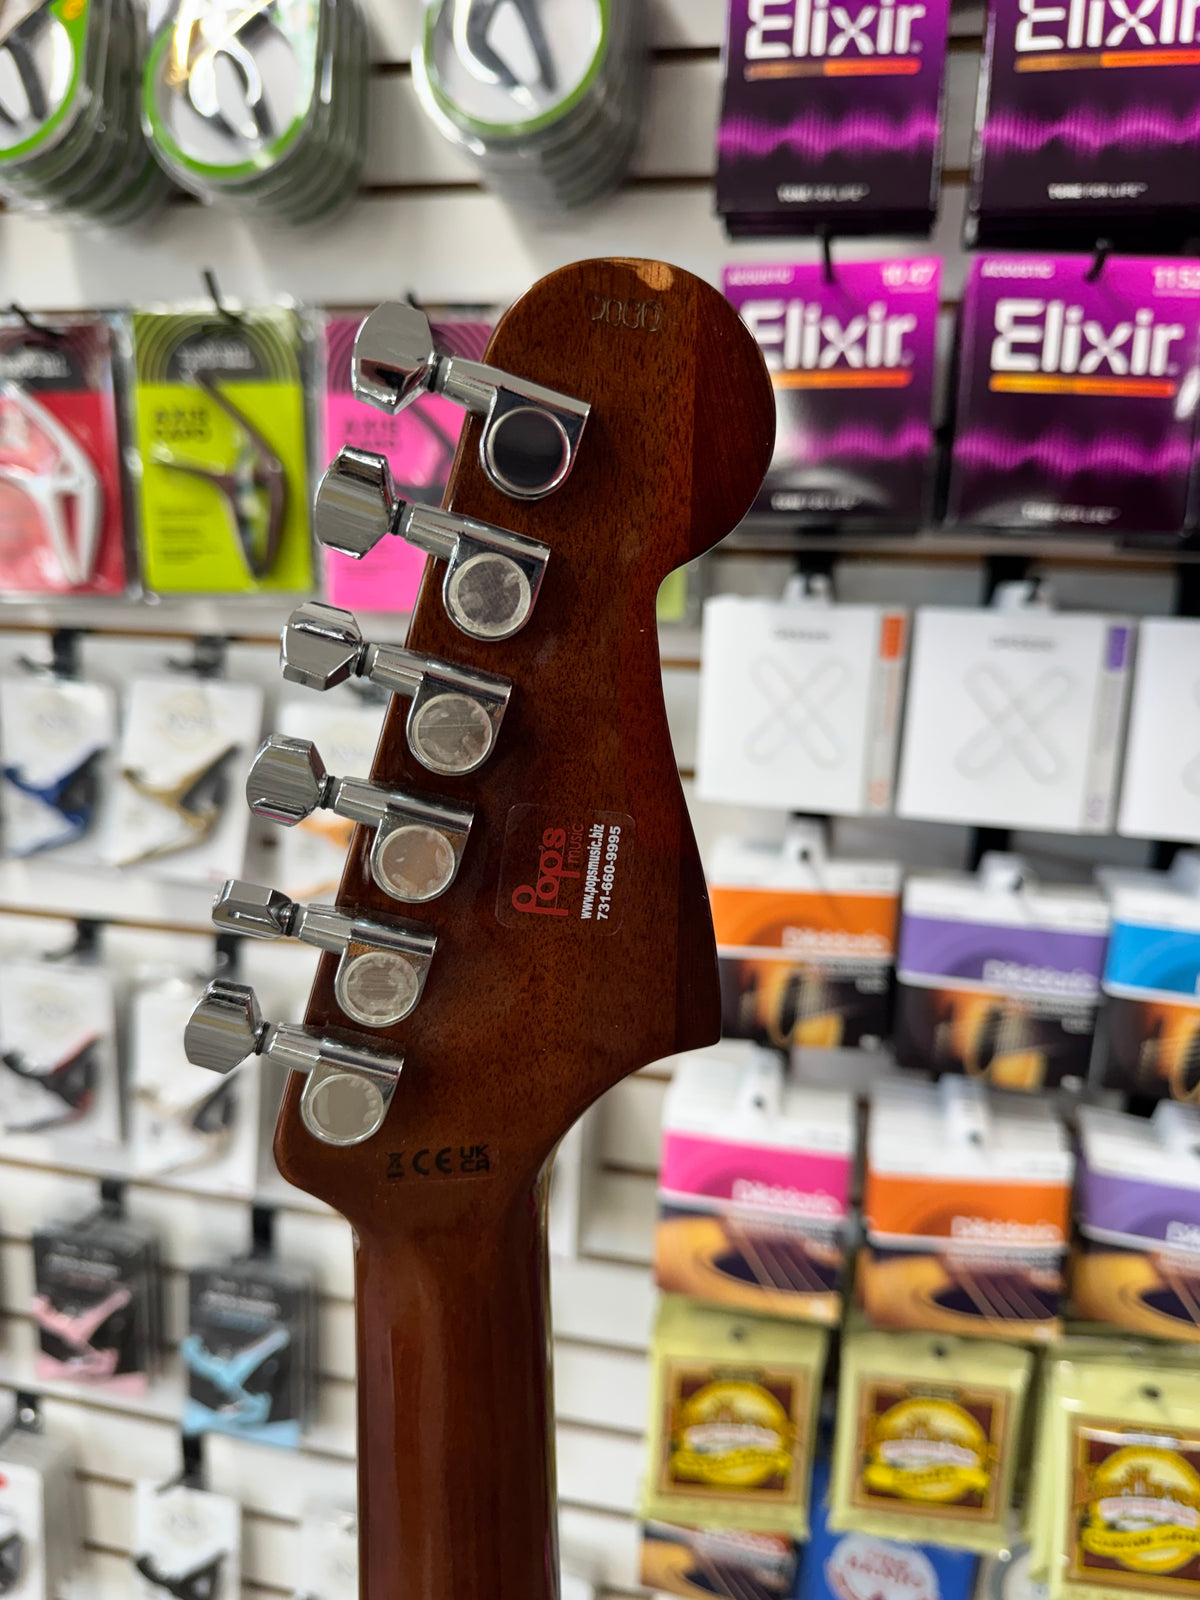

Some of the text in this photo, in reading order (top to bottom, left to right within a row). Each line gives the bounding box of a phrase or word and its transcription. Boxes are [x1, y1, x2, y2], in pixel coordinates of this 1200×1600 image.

[745, 0, 926, 60] Elixir
[740, 299, 917, 370] Elixir
[990, 297, 1185, 377] Elixir
[567, 823, 585, 865] music
[580, 823, 605, 920] www.popsmusic.biz
[596, 825, 622, 921] 731-660-9995
[412, 1147, 453, 1175] CE
